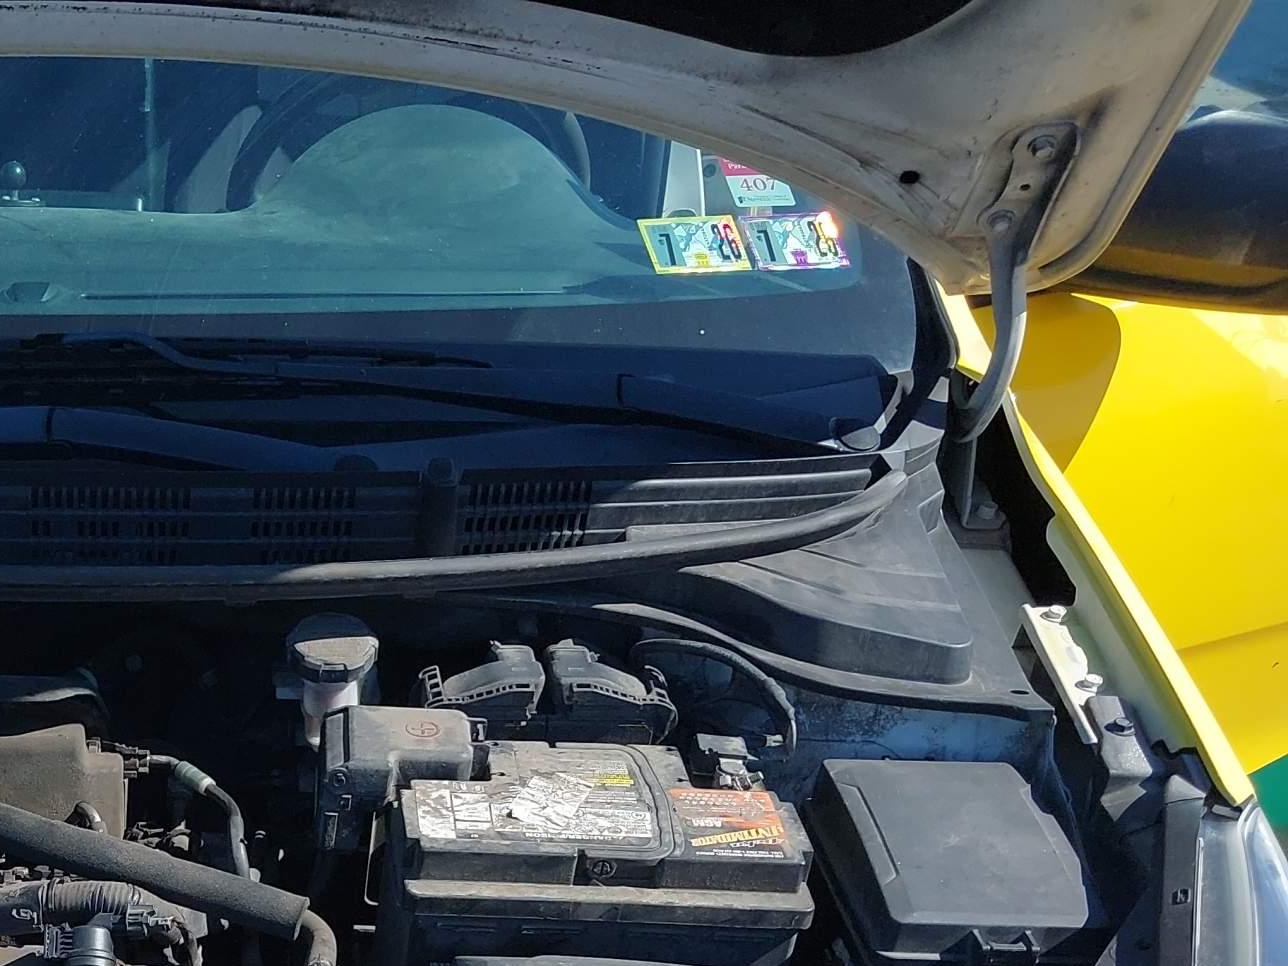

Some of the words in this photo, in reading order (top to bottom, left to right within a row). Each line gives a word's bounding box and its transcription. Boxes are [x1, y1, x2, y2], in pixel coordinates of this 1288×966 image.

[740, 177, 777, 192] 407
[710, 223, 742, 261] 26
[692, 818, 722, 828] AGM
